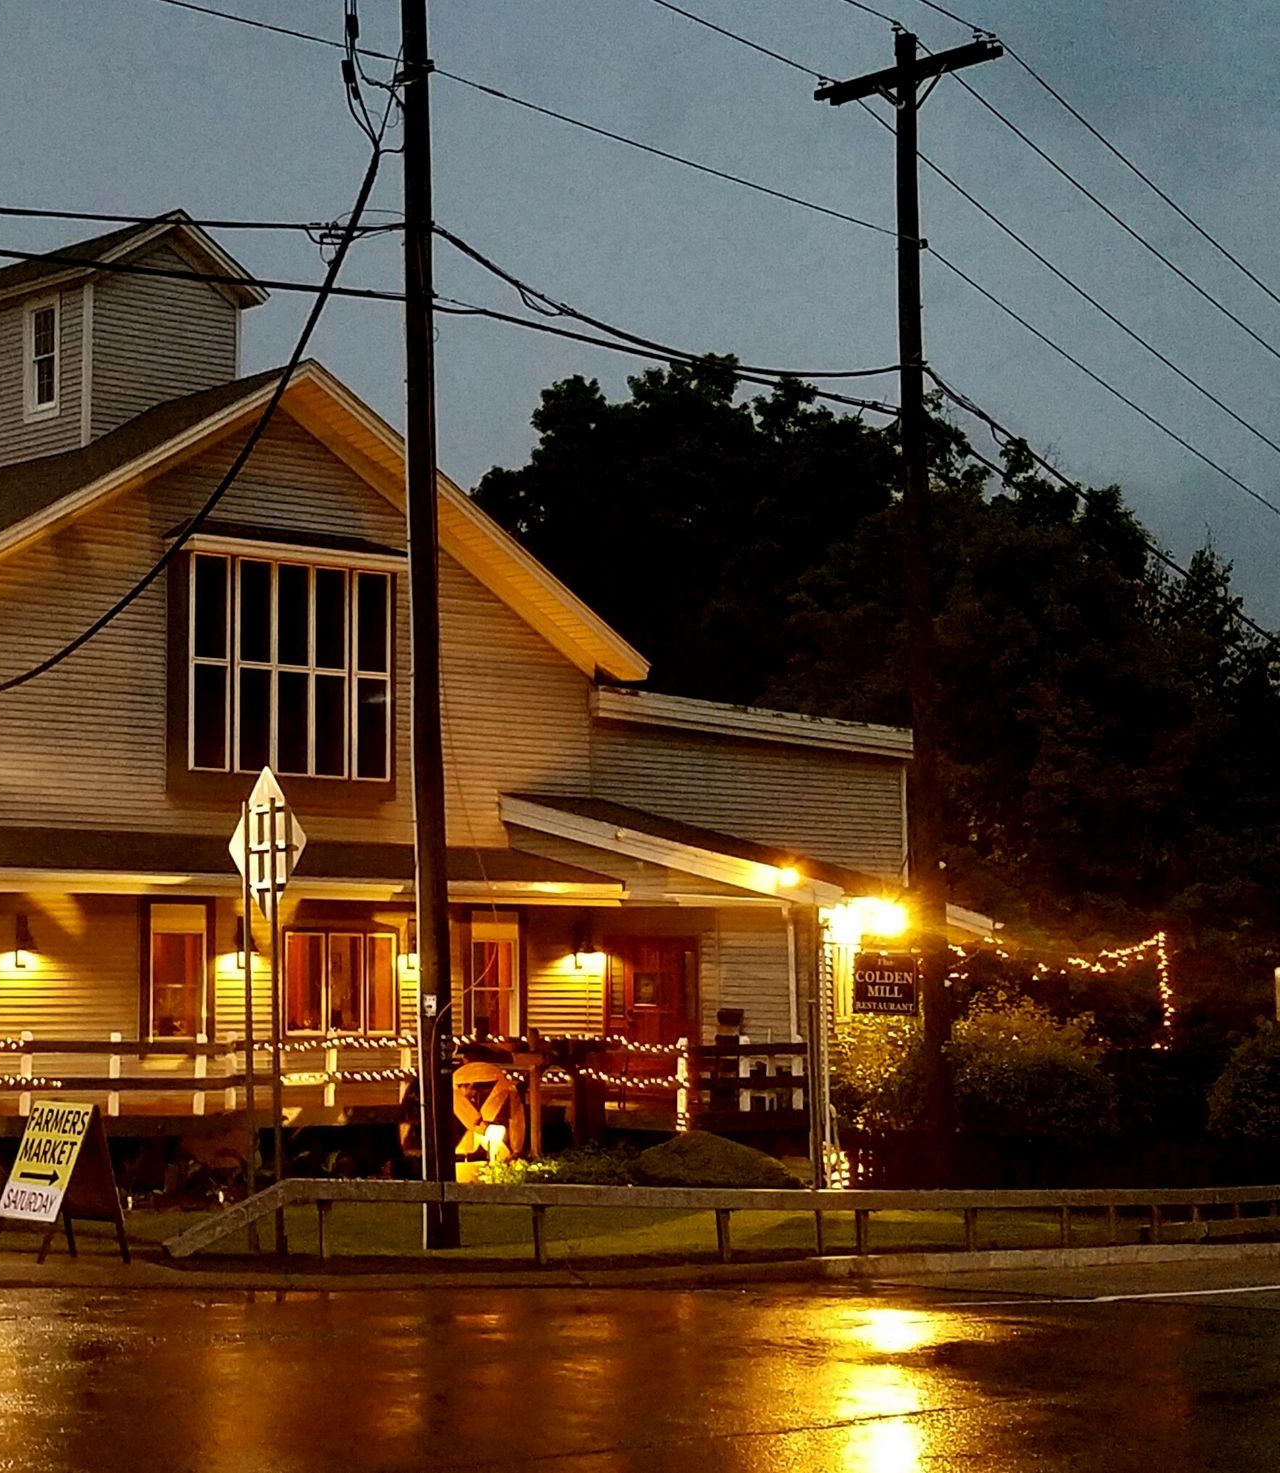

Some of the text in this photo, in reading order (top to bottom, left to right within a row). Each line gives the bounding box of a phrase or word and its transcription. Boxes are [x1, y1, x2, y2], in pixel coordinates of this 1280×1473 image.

[867, 985, 903, 998] MILL
[855, 1001, 915, 1012] RESTAURANT
[26, 1106, 90, 1137] FARMERS
[18, 1136, 78, 1166] MARKET
[2, 1187, 59, 1215] SATURDAY
